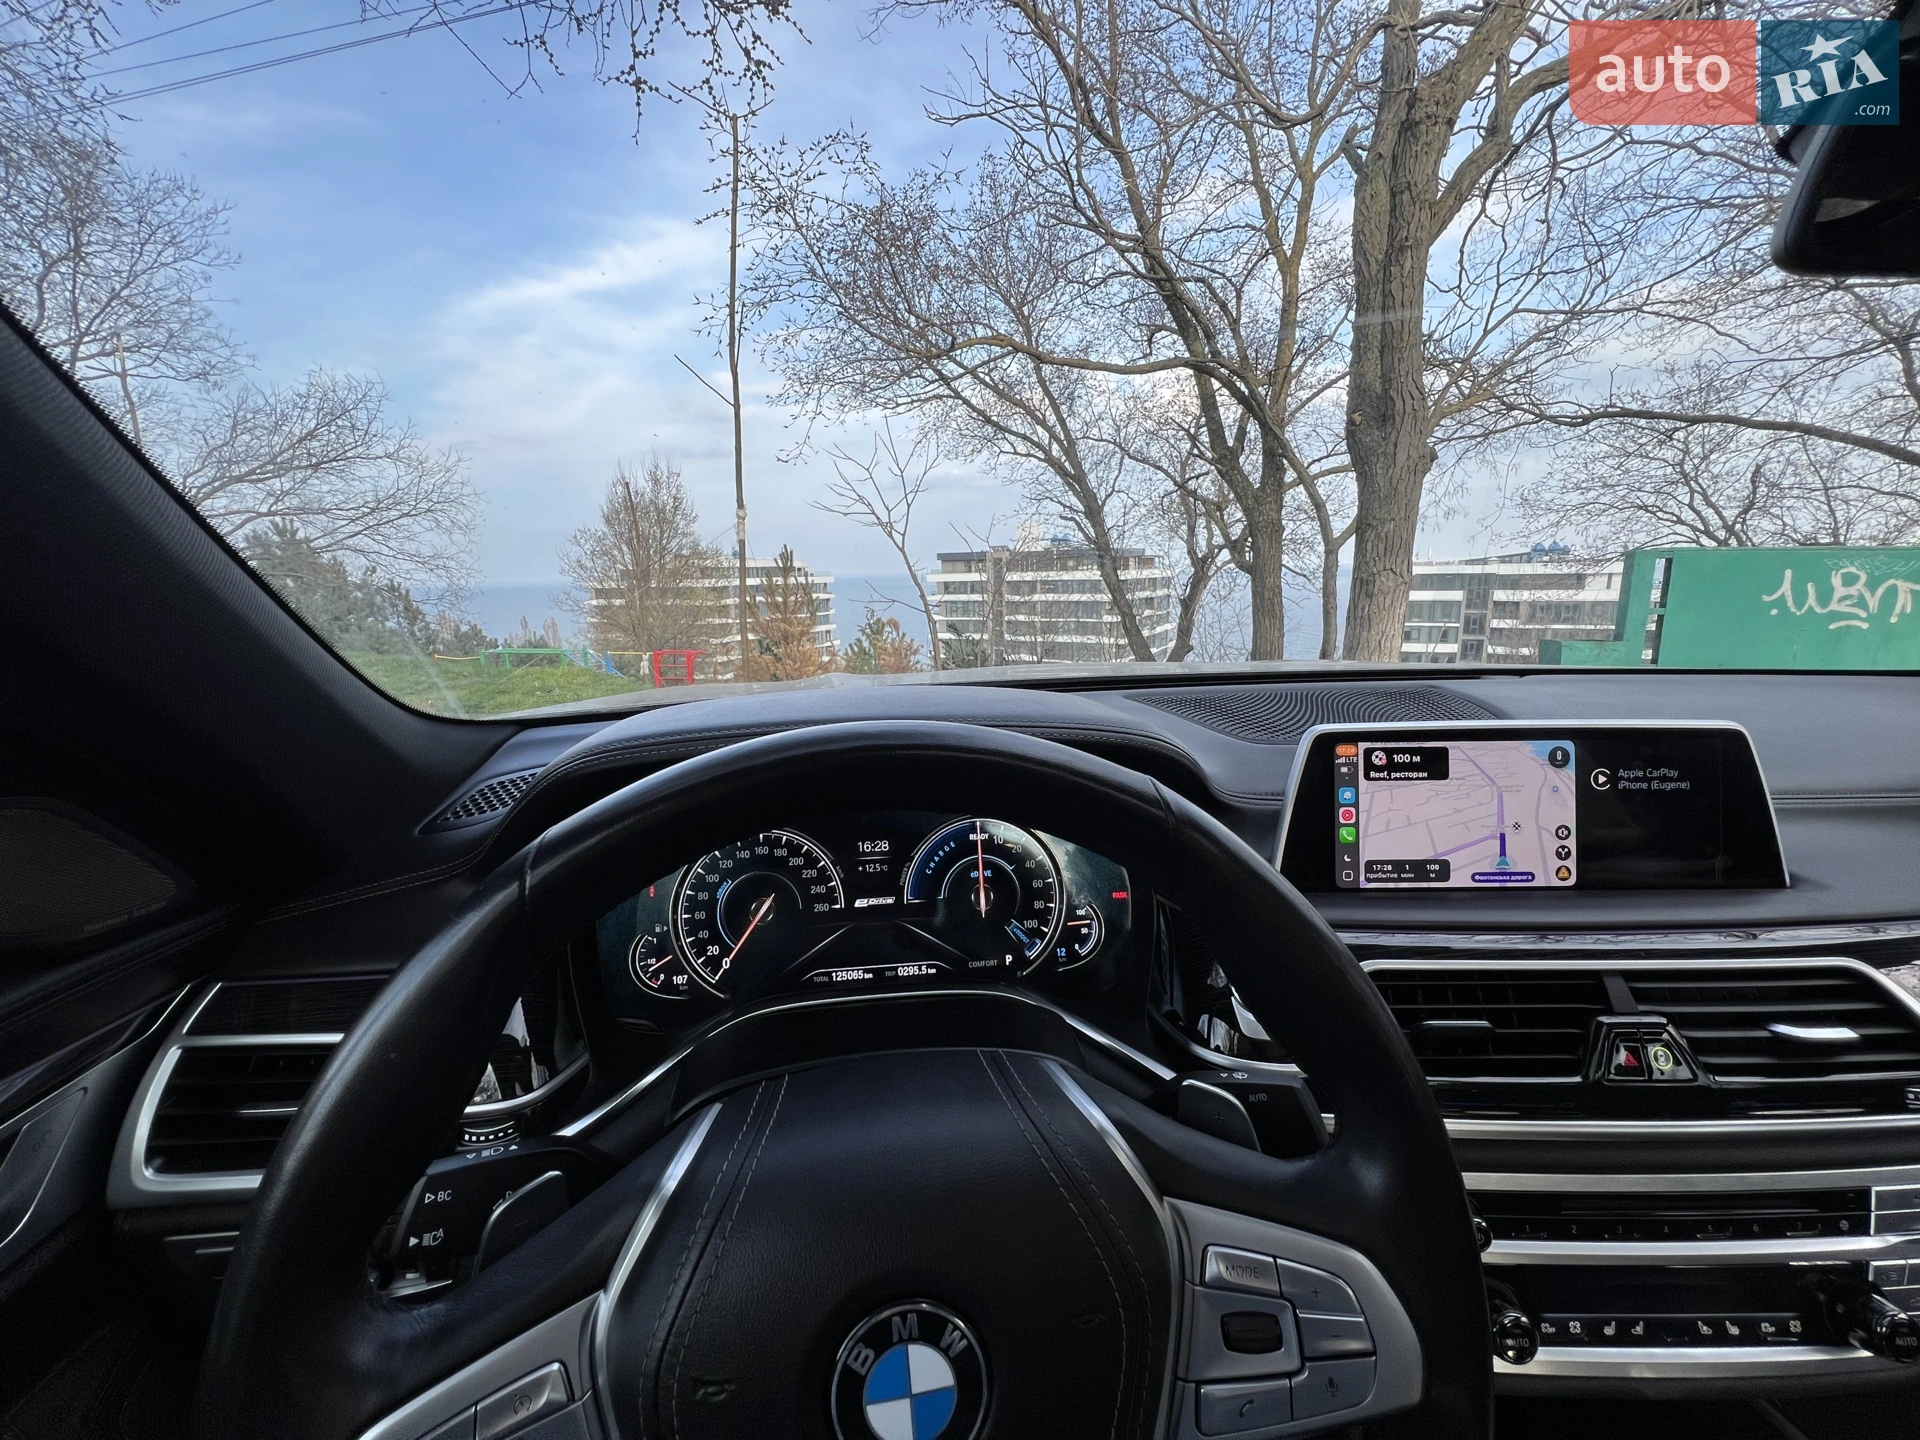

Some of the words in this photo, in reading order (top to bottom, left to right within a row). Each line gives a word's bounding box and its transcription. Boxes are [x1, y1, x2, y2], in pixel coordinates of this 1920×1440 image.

[1392, 754, 1411, 763] 100
[1370, 770, 1389, 779] Reef,
[1391, 771, 1428, 780] ресторан
[1618, 768, 1644, 778] Apple
[1646, 768, 1679, 779] CarPlay
[1618, 780, 1649, 790] iPhone
[1650, 780, 1691, 791] (Eugene)
[969, 833, 990, 841] READY
[993, 835, 1004, 845] 10
[857, 840, 889, 852] 16:28
[1011, 845, 1022, 853] 20
[736, 850, 750, 858] 140
[754, 847, 769, 855] 160
[773, 848, 788, 856] 180
[788, 857, 804, 866] 200
[926, 841, 956, 874] CHARGE
[719, 860, 733, 868] 120
[1025, 860, 1036, 868] 40
[705, 873, 720, 883] 100
[801, 869, 818, 878] 220
[1032, 879, 1043, 888] 60
[810, 885, 826, 893] 240
[697, 892, 709, 900] 80
[813, 903, 830, 912] 260
[1033, 900, 1045, 909] 80
[694, 911, 706, 920] 60
[1022, 919, 1038, 928] 100
[697, 930, 709, 939] 40
[706, 945, 720, 955] 20
[1056, 947, 1066, 956] 12
[722, 958, 731, 969] 0
[968, 959, 998, 969] COMFORT
[1005, 955, 1013, 966] P
[813, 975, 829, 983] TOTAL
[831, 971, 864, 982] 125065
[897, 965, 927, 976] 0295.5
[672, 975, 688, 985] 107
[1249, 1093, 1268, 1102] AUTO
[437, 1191, 452, 1202] BC
[1225, 1265, 1260, 1279] MODE
[846, 1312, 968, 1377] BMW
[1895, 1337, 1918, 1346] AUTO
